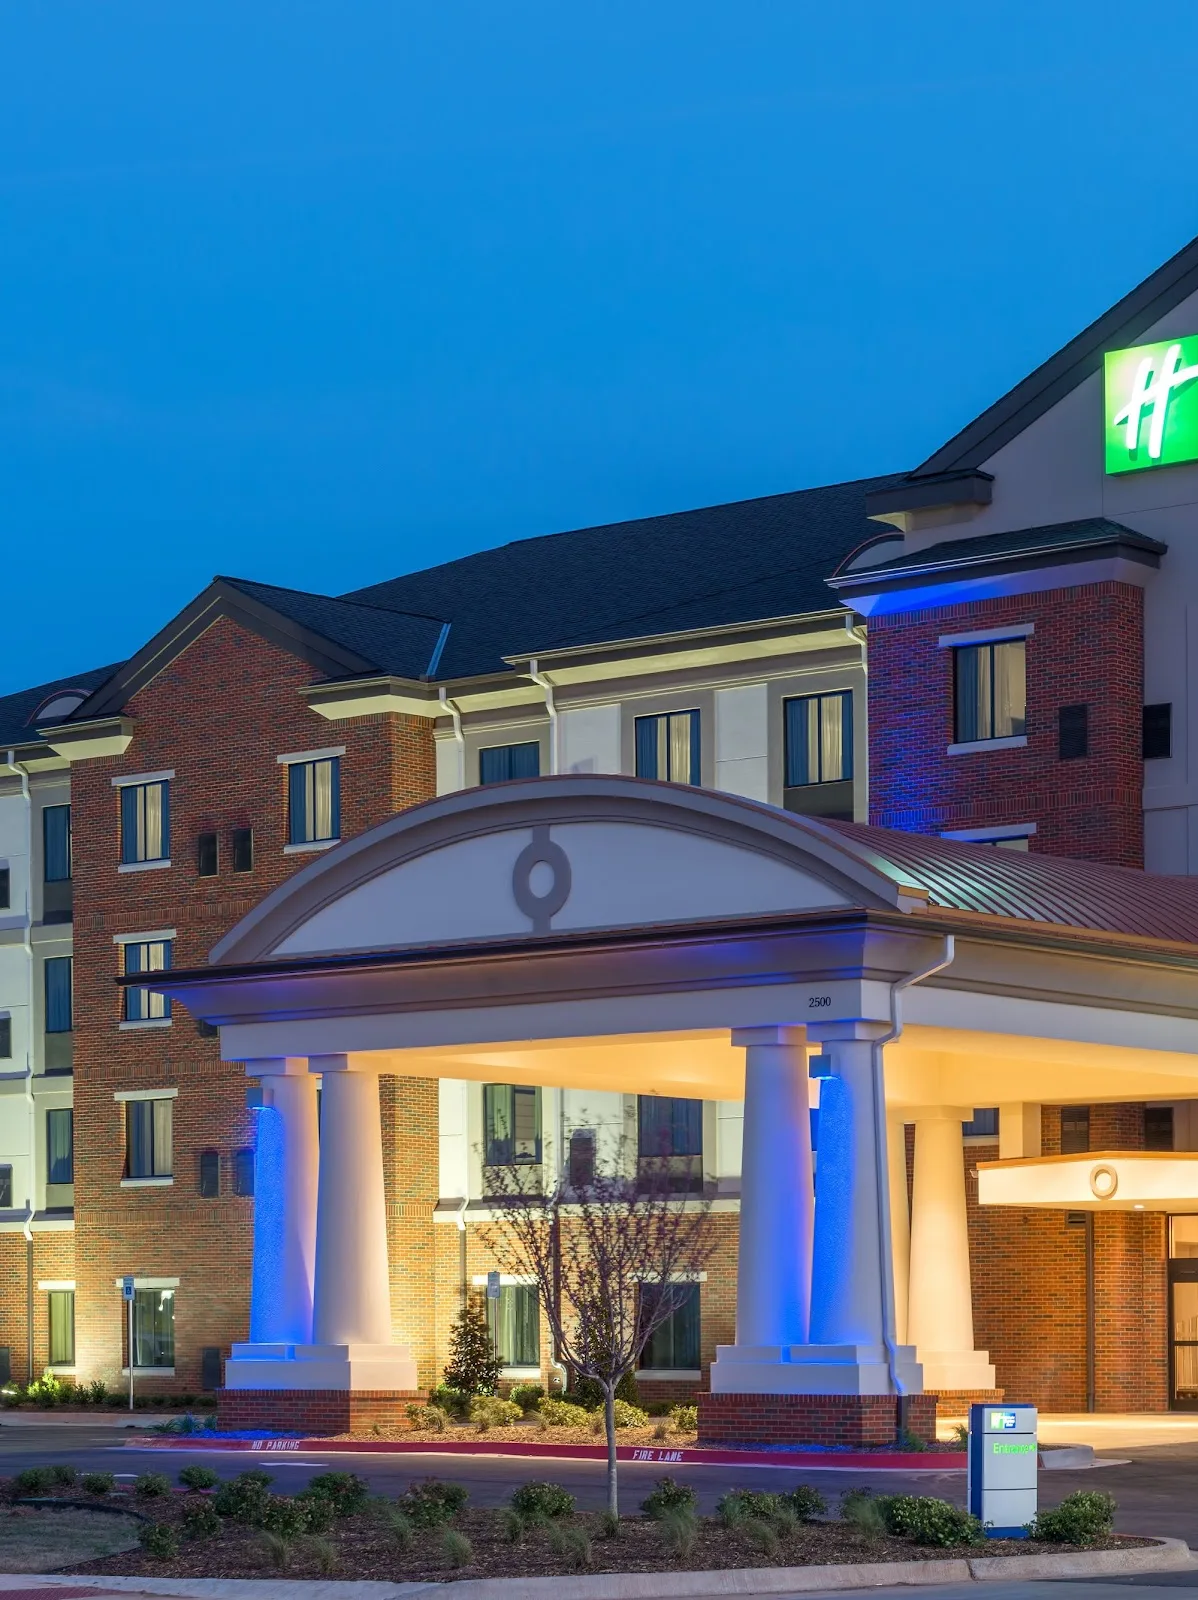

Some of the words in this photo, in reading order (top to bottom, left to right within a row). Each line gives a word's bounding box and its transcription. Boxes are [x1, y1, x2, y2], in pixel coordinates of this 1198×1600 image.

[808, 996, 832, 1008] 2500
[251, 1440, 262, 1450] NO
[266, 1440, 300, 1451] PARKING
[993, 1442, 1029, 1454] Entrance
[632, 1449, 654, 1461] FIRE
[658, 1450, 684, 1462] LANE
